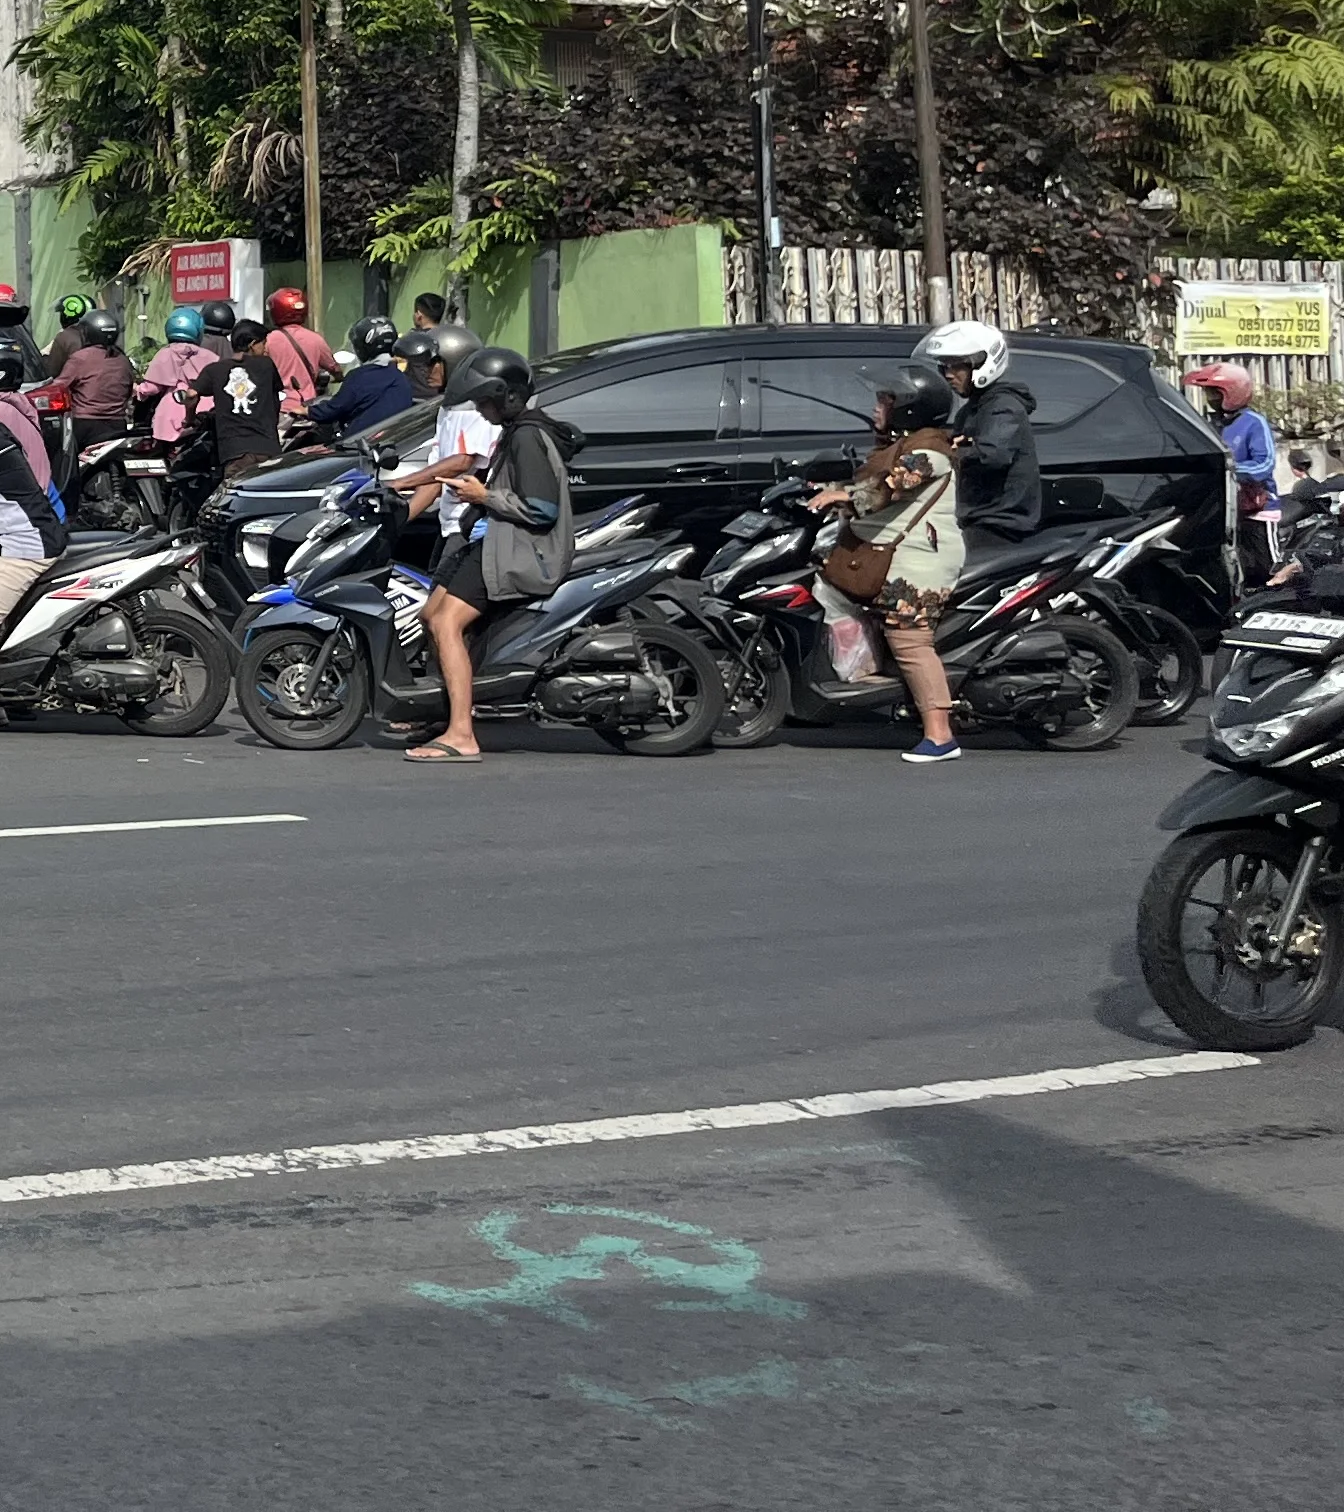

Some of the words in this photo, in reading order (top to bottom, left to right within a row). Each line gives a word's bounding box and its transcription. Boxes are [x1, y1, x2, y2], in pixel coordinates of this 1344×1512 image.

[1183, 299, 1227, 324] Dijual
[1295, 301, 1320, 317] YUS
[1238, 318, 1265, 332] 0851
[1267, 318, 1294, 333] 0577
[1297, 319, 1320, 334] 5123
[1235, 334, 1261, 348] 0812
[1264, 335, 1293, 348] 3564
[1295, 335, 1321, 350] 9775
